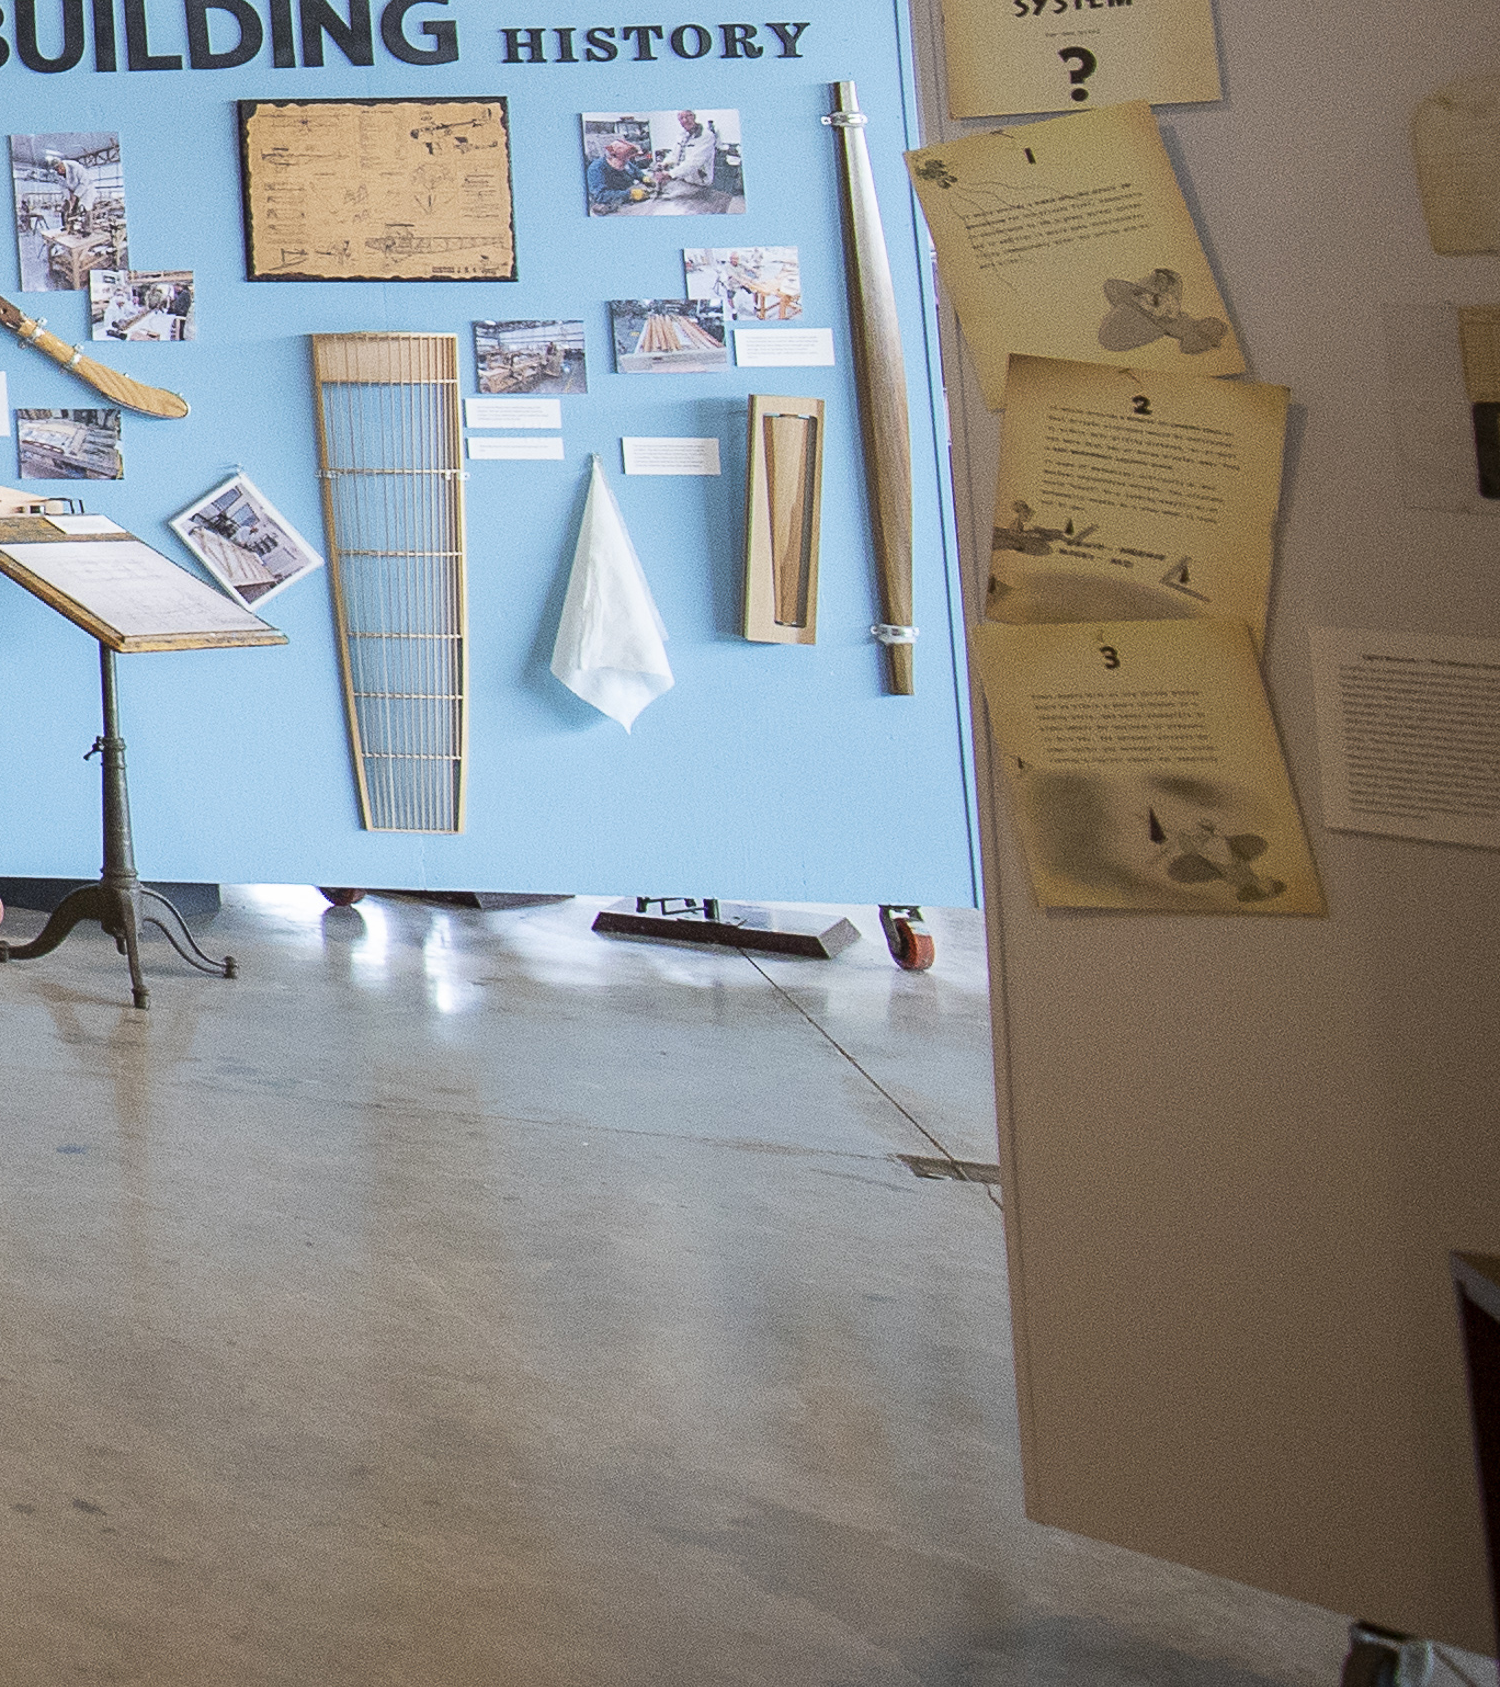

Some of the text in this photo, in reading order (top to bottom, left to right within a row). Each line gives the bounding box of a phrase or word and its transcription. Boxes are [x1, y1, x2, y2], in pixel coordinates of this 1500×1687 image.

[500, 20, 811, 65] HISTORY
[1057, 46, 1098, 102] ?
[1024, 146, 1037, 165] 1
[1132, 394, 1153, 415] 2
[1099, 645, 1121, 670] 3
